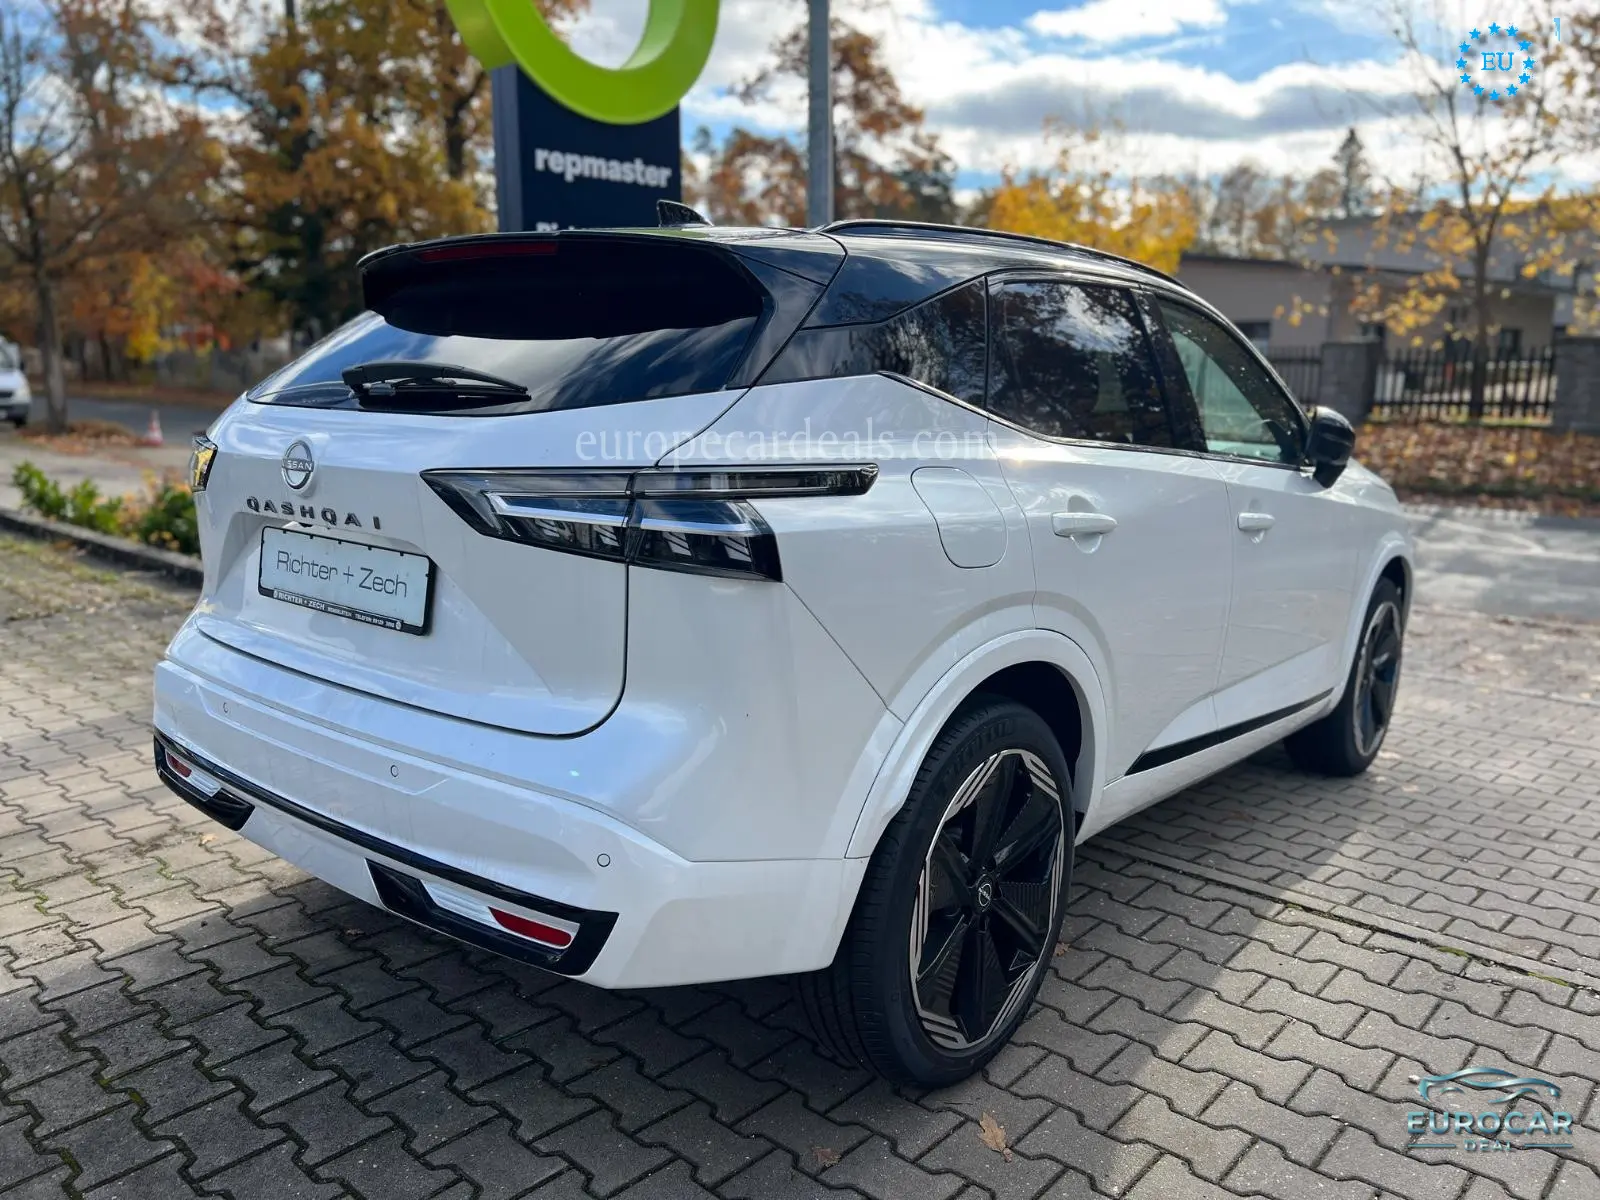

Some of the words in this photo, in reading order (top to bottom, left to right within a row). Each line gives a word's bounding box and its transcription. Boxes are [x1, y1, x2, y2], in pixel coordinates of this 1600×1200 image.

[534, 148, 672, 188] repmaster
[283, 458, 313, 472] SSAN
[246, 496, 381, 530] QASHQAI
[276, 550, 338, 581] Richter
[343, 565, 354, 584] +
[358, 567, 408, 598] Zech
[278, 592, 303, 605] RICHTER
[308, 600, 325, 610] ZECH
